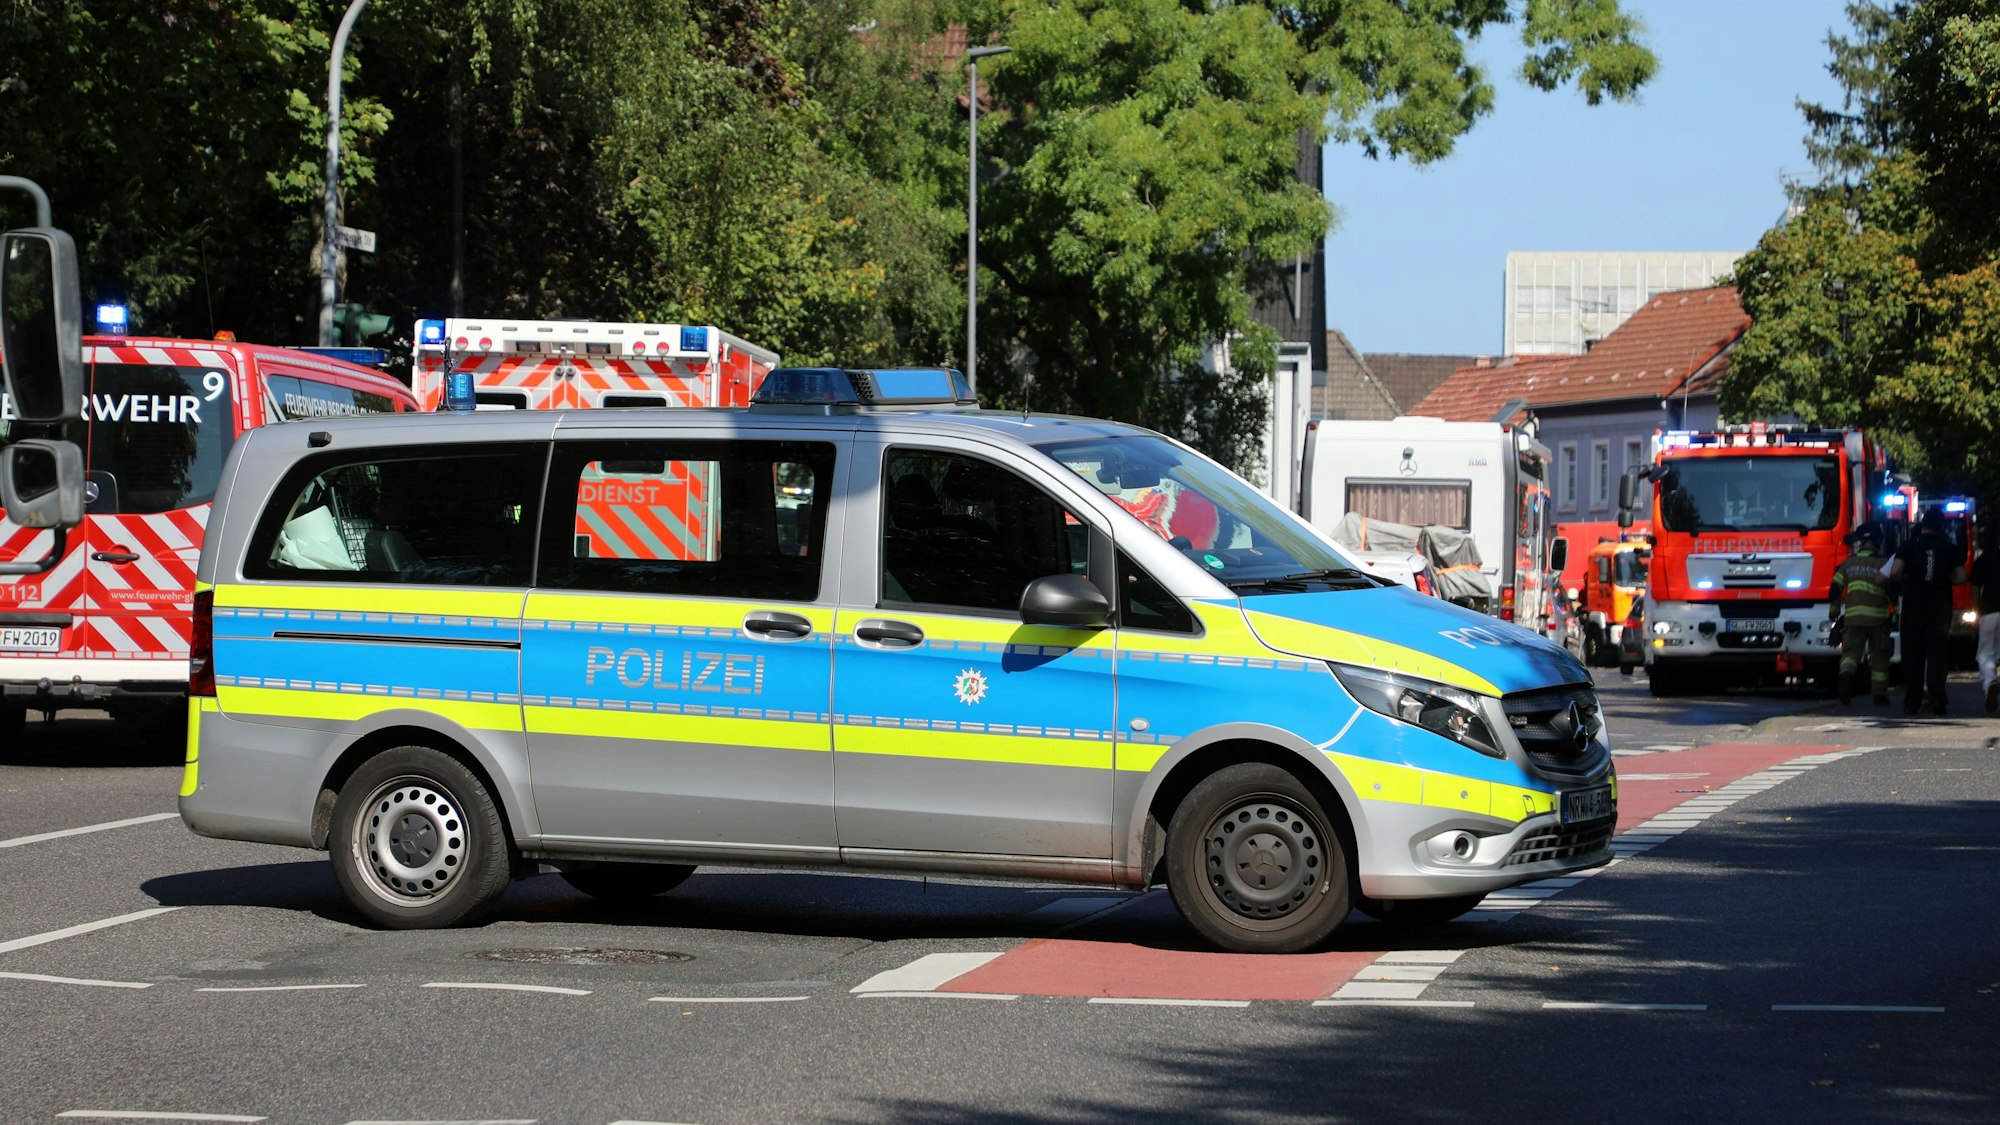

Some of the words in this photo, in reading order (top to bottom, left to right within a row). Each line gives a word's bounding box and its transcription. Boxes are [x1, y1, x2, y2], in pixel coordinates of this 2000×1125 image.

[202, 371, 225, 402] 9
[1, 393, 202, 423] ERWEHR
[285, 393, 327, 417] FEUERWEHR
[581, 484, 660, 504] DIENST
[1694, 538, 1804, 553] FEUERWEHR
[8, 585, 38, 601] 112
[24, 631, 57, 647] 2019
[586, 646, 765, 696] POLIZEI
[1569, 794, 1586, 820] NRW
